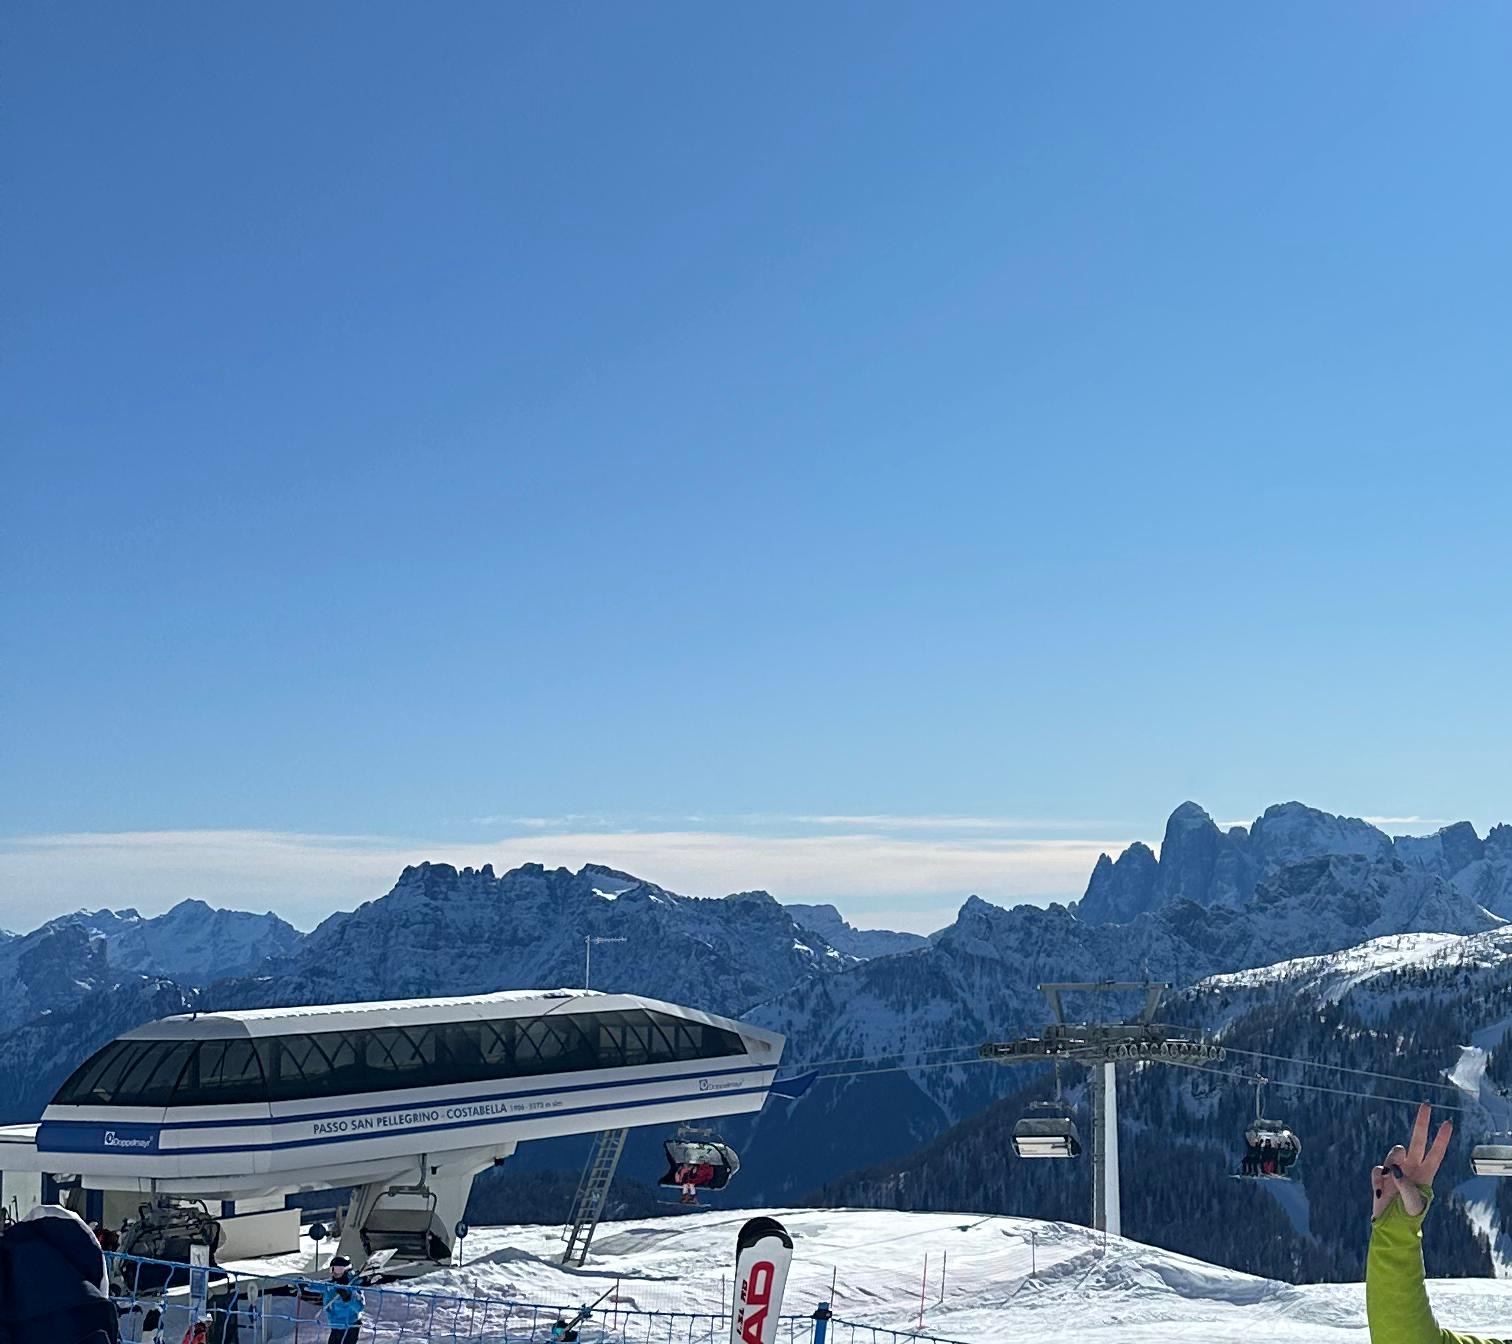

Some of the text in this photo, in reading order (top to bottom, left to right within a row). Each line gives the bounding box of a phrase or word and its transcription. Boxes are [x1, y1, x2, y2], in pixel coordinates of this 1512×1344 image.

[313, 1120, 348, 1135] PASSO
[351, 1117, 374, 1131] SAN
[376, 1110, 440, 1128] PELLEGRINO
[446, 1103, 507, 1119] COSTABELLA
